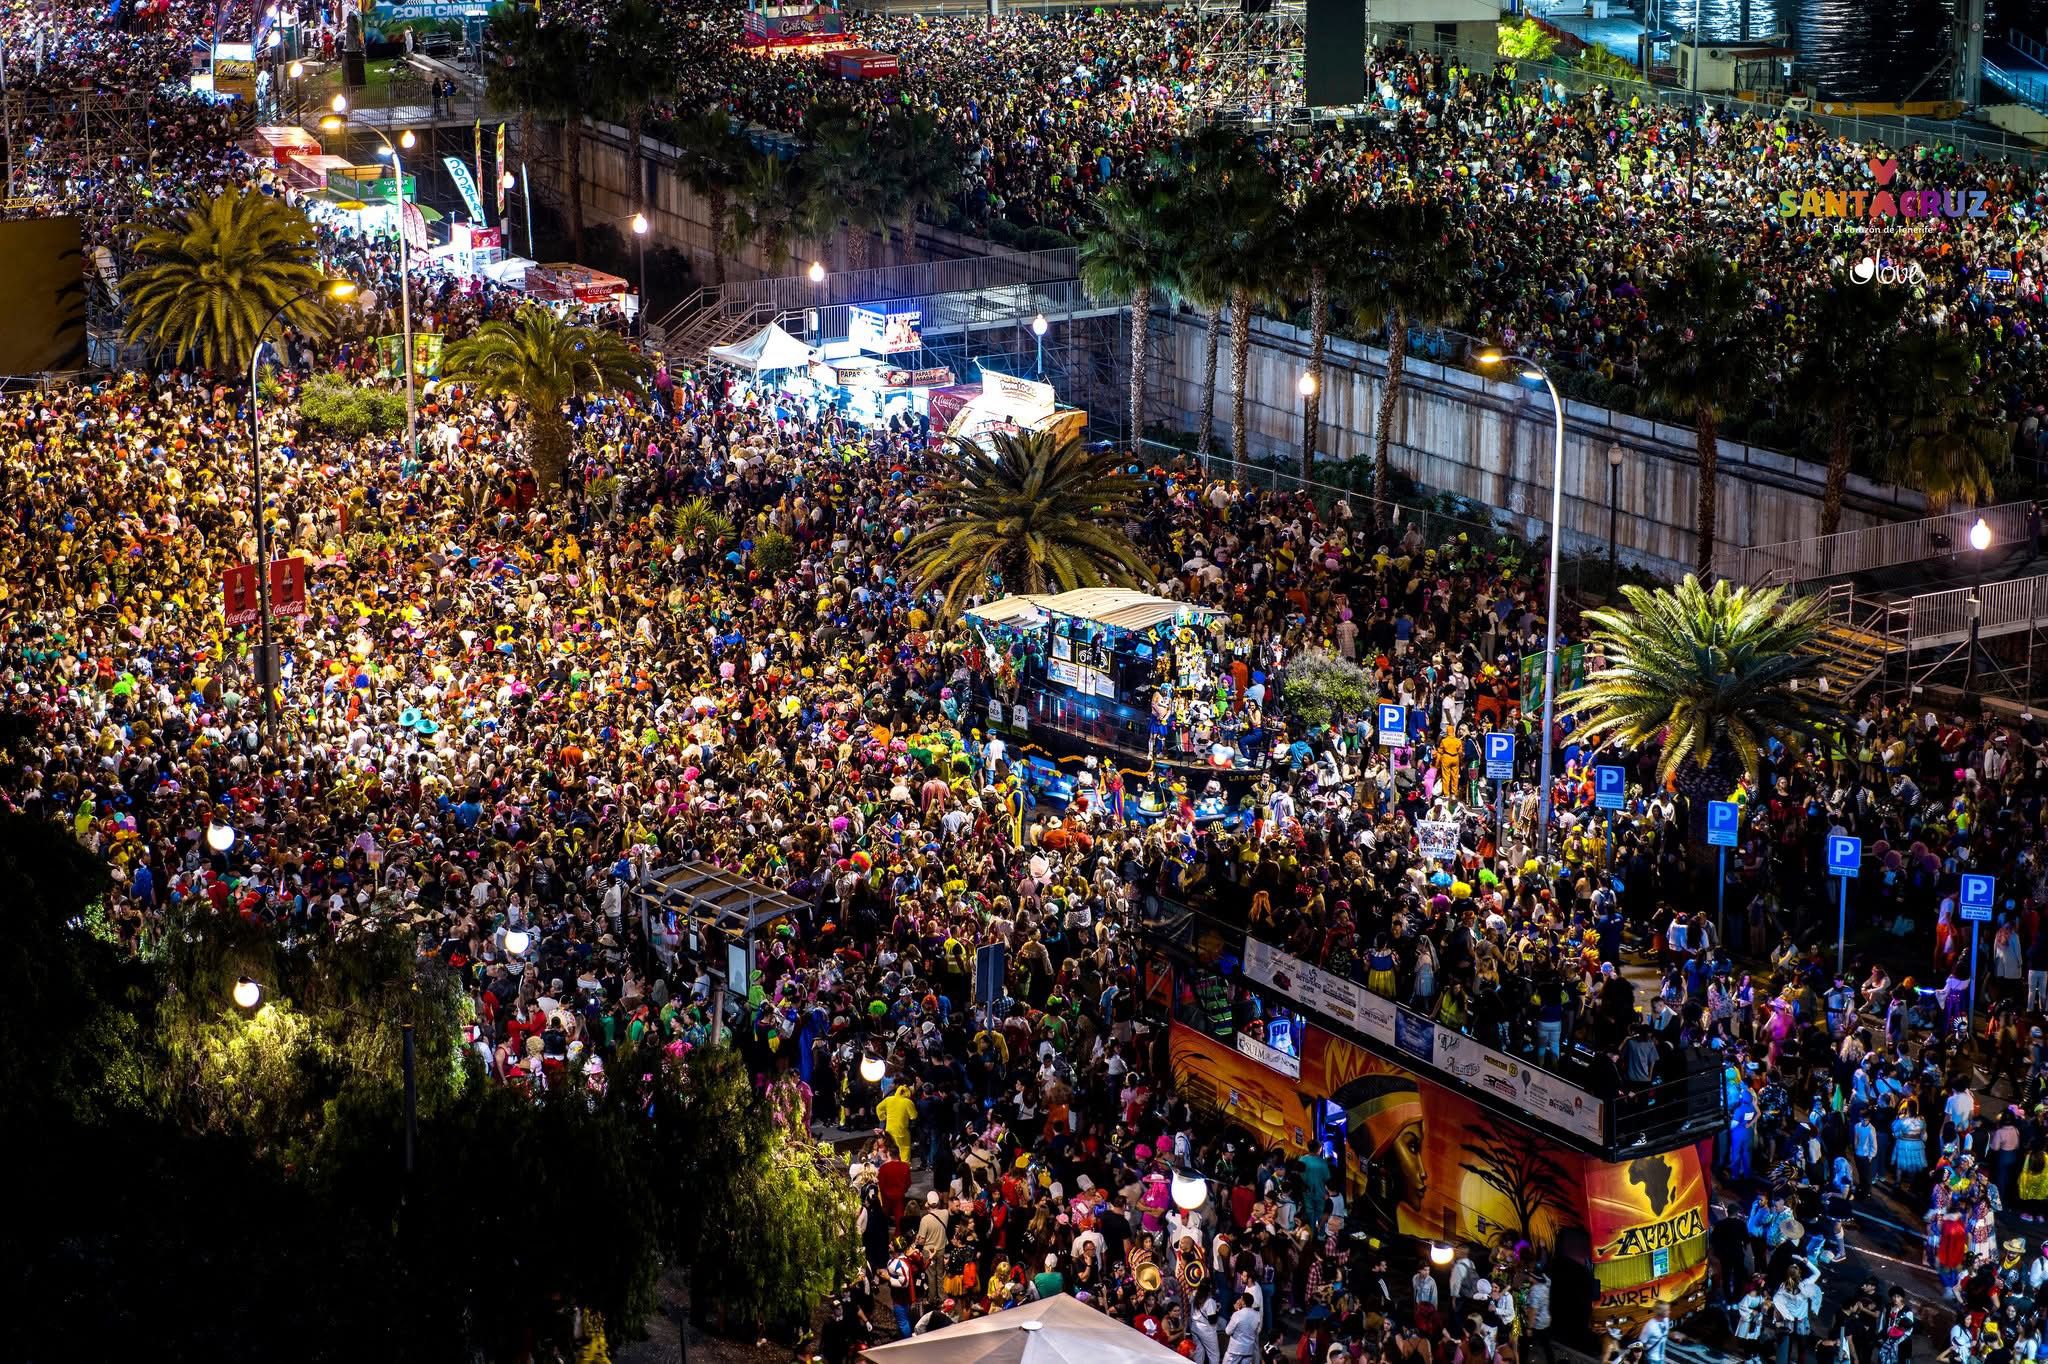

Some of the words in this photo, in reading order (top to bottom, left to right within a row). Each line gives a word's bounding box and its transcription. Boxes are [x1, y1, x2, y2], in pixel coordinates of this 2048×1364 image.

[392, 7, 422, 18] CON
[424, 6, 433, 17] EL
[1384, 708, 1400, 729] P
[1491, 736, 1509, 758] P
[1601, 769, 1619, 791] P
[1714, 805, 1732, 827] P
[1836, 840, 1854, 863] P
[1967, 879, 1988, 902] P
[1615, 1208, 1705, 1256] AFRICA
